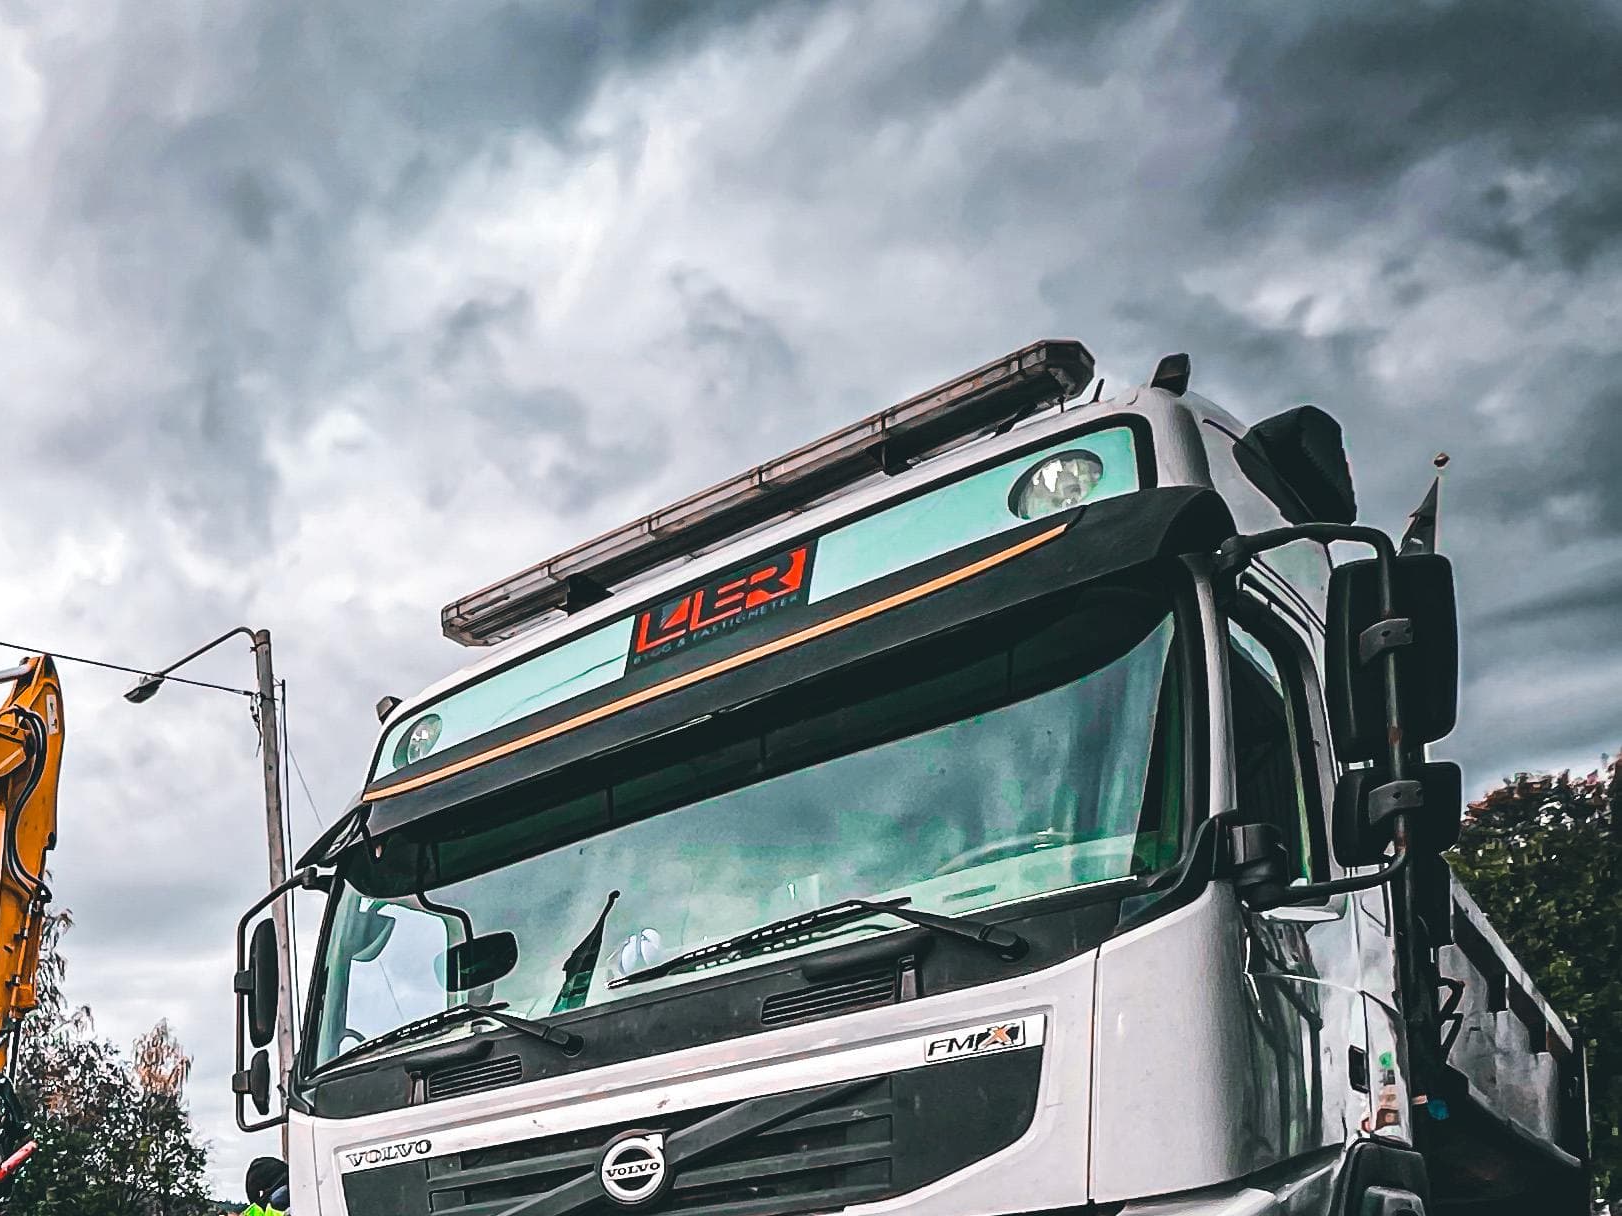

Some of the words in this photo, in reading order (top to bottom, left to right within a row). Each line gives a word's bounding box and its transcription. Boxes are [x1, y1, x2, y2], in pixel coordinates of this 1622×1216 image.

[927, 1022, 1020, 1057] FMX
[345, 1139, 433, 1168] VOLVO
[605, 1160, 661, 1178] VOLVO
